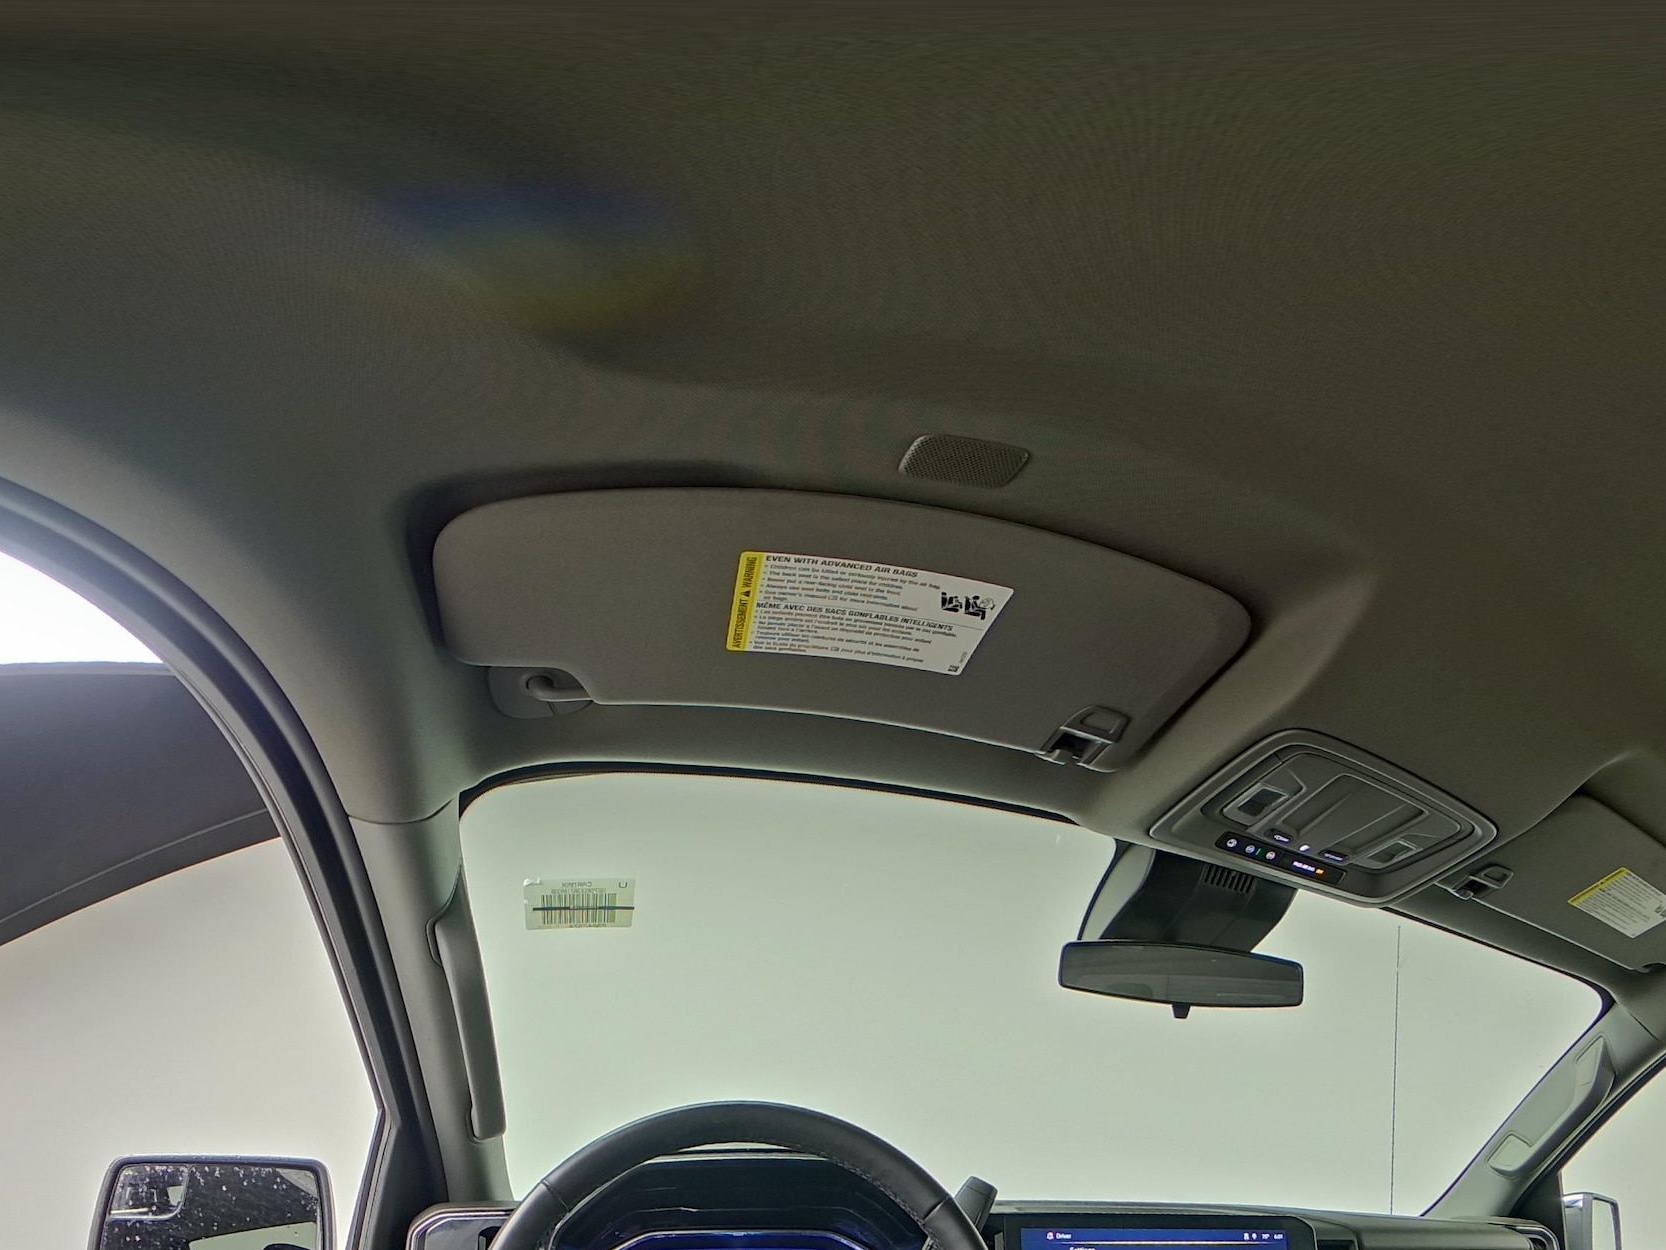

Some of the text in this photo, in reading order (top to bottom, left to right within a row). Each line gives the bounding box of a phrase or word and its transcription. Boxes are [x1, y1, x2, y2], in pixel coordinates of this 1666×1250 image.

[743, 557, 757, 588] WARNING
[821, 560, 872, 571] ADVANCED
[874, 566, 891, 574] AIR
[893, 569, 918, 577] BAGS
[732, 598, 749, 648] AVERTISSEMENT
[825, 608, 847, 616] SACS
[849, 610, 899, 622] GONFLABLES
[901, 618, 953, 631] INTELLIGENTS
